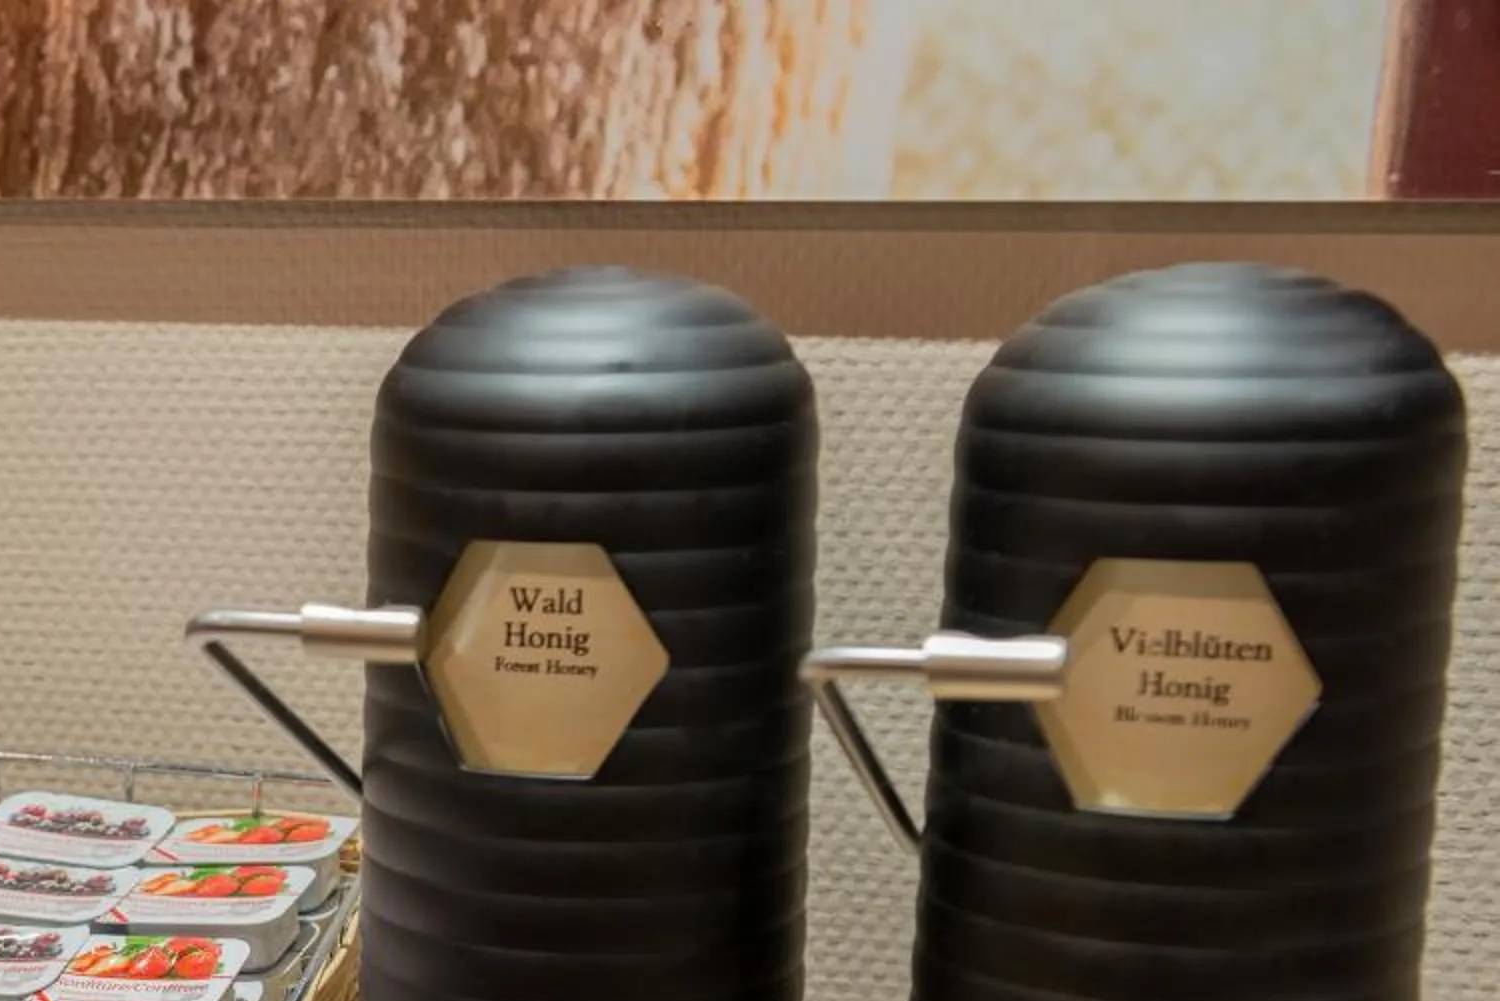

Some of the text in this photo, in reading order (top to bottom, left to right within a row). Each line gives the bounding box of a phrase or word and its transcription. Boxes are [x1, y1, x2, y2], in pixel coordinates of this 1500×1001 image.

[509, 586, 583, 616] Wald
[503, 621, 591, 656] Honig
[1109, 626, 1274, 663] Vielblüten
[494, 655, 599, 680] Forest Honey
[1137, 670, 1232, 707] Honig
